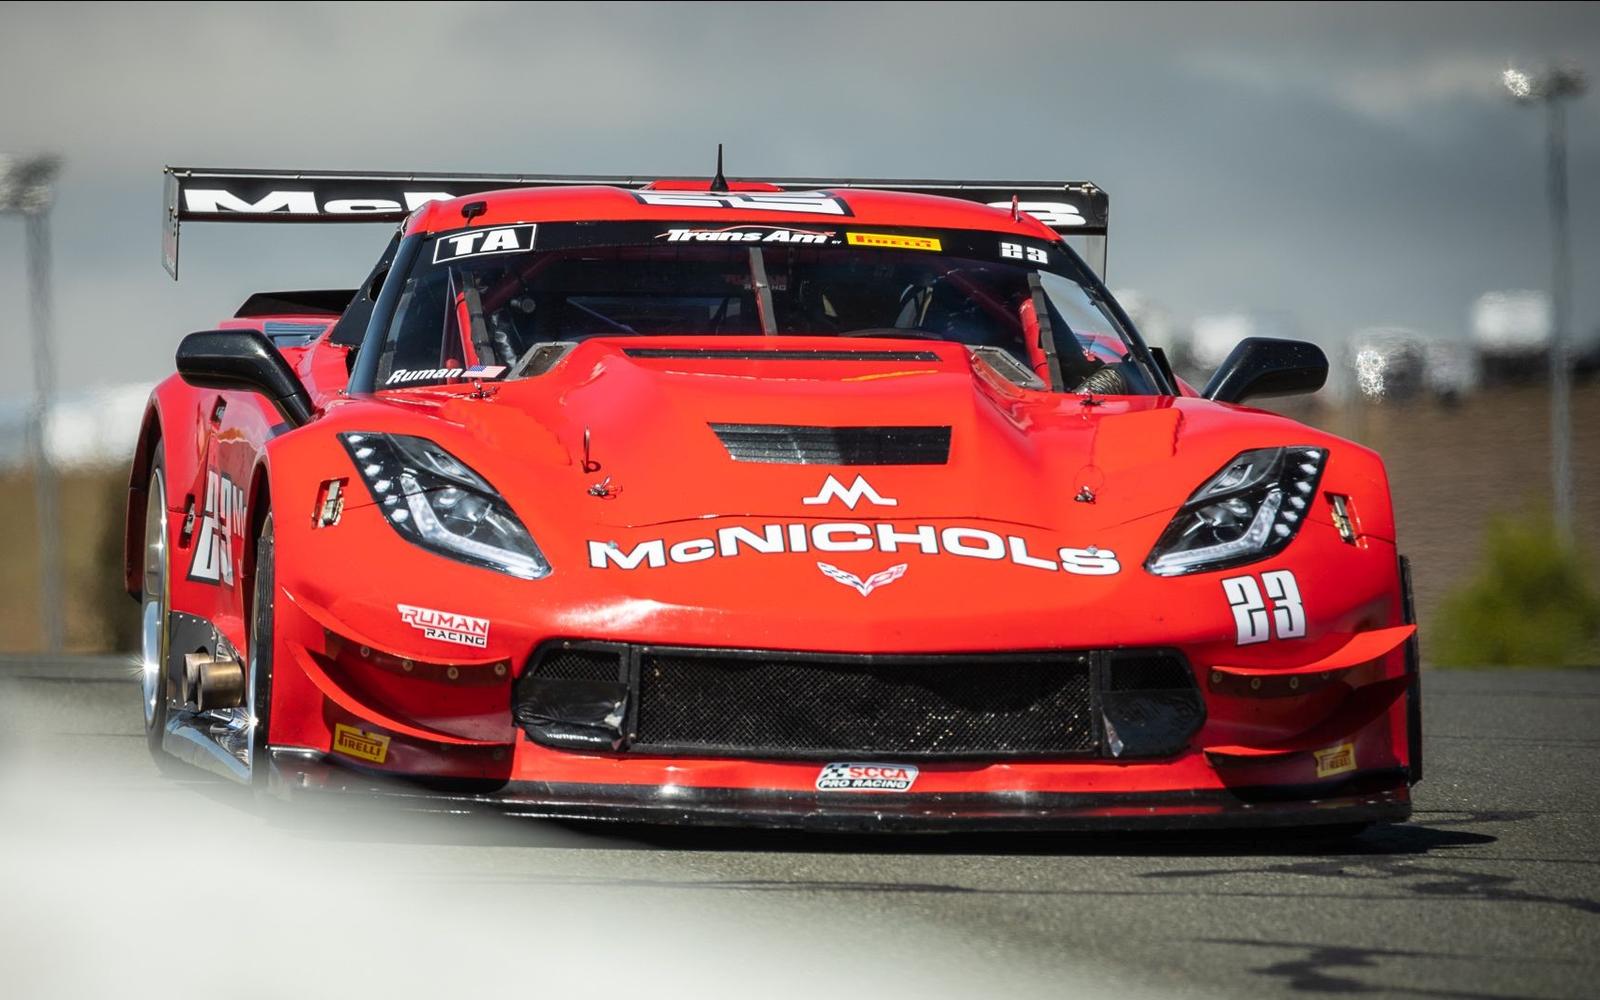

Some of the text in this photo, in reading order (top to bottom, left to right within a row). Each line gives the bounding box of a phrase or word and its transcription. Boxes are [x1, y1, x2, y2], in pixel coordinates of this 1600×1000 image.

[449, 229, 519, 256] TA
[667, 229, 762, 242] Trans
[762, 230, 829, 244] Am
[1001, 242, 1048, 265] 23
[385, 368, 463, 385] Ruman
[188, 470, 235, 588] 23
[588, 522, 1121, 576] McNICHOLS
[1220, 568, 1307, 647] 23
[402, 607, 487, 636] RUMAN
[425, 627, 486, 647] RACING
[339, 730, 383, 757] PIRELLI
[820, 779, 908, 790] PRO RACING
[849, 766, 909, 780] SCCA
